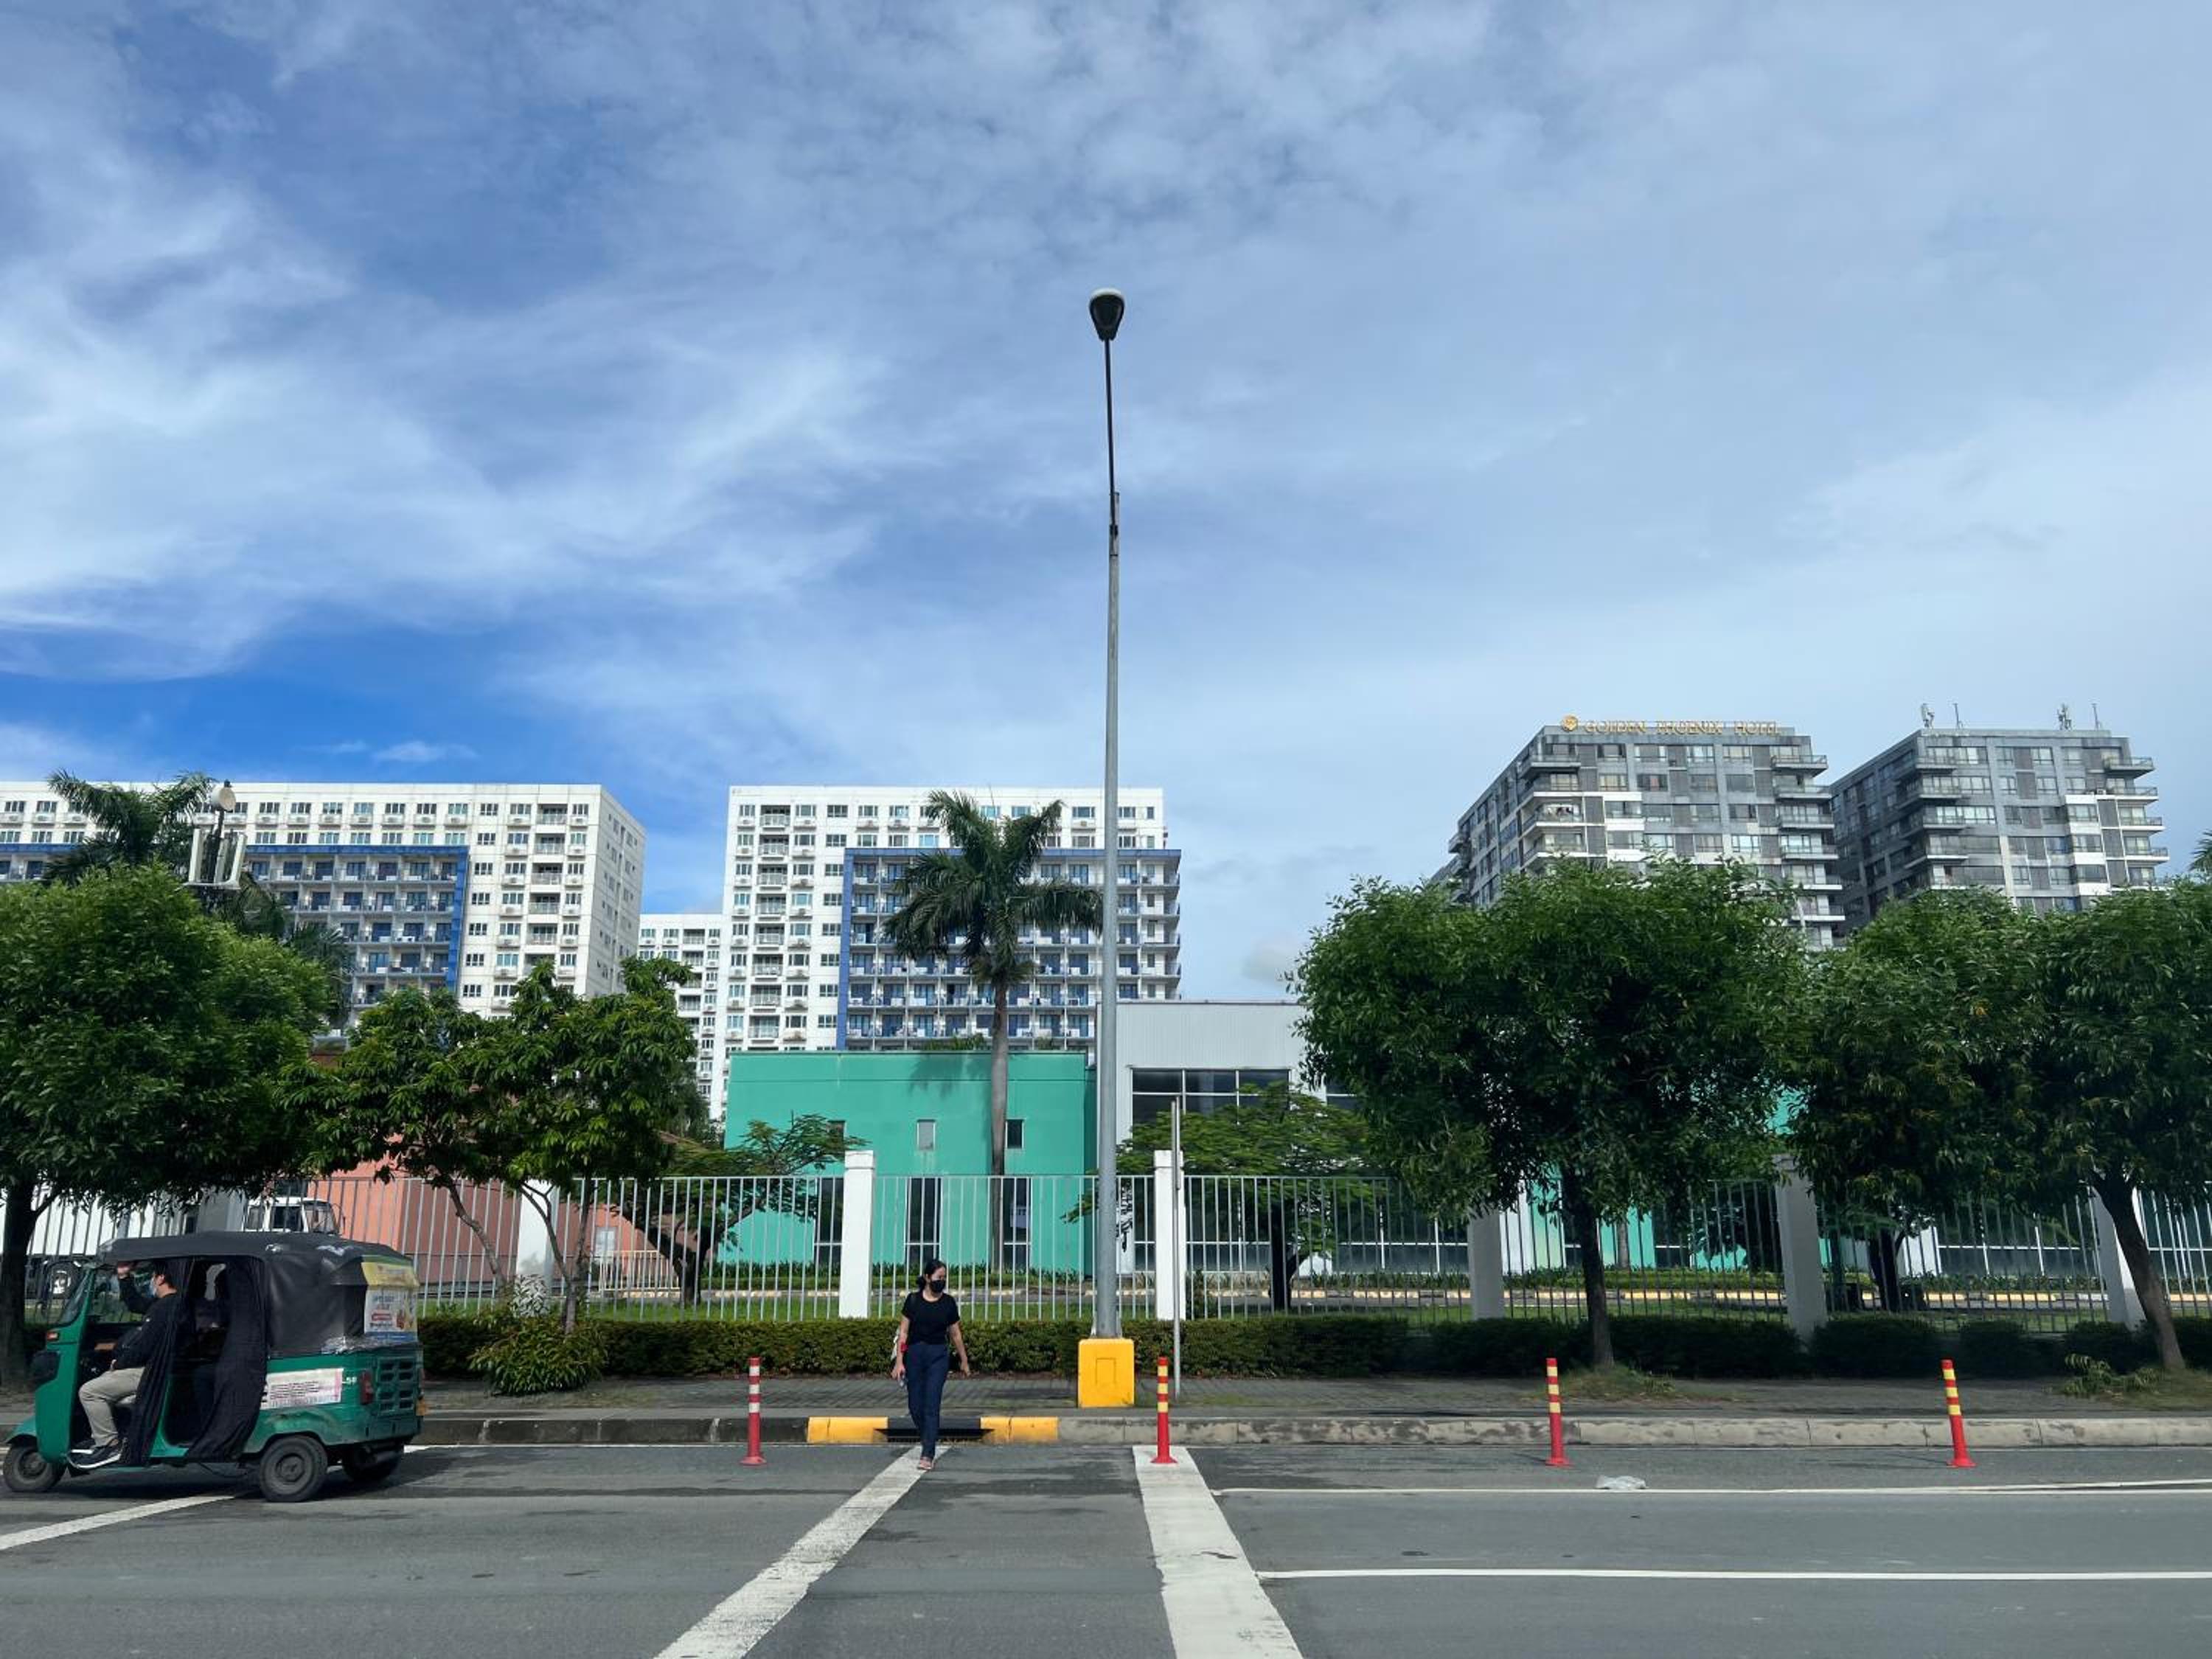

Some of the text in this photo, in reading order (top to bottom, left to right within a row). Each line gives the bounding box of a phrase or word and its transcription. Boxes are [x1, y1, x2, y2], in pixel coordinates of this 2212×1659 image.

[1585, 720, 1780, 734] GOLDEN PHOENIX HOTEL
